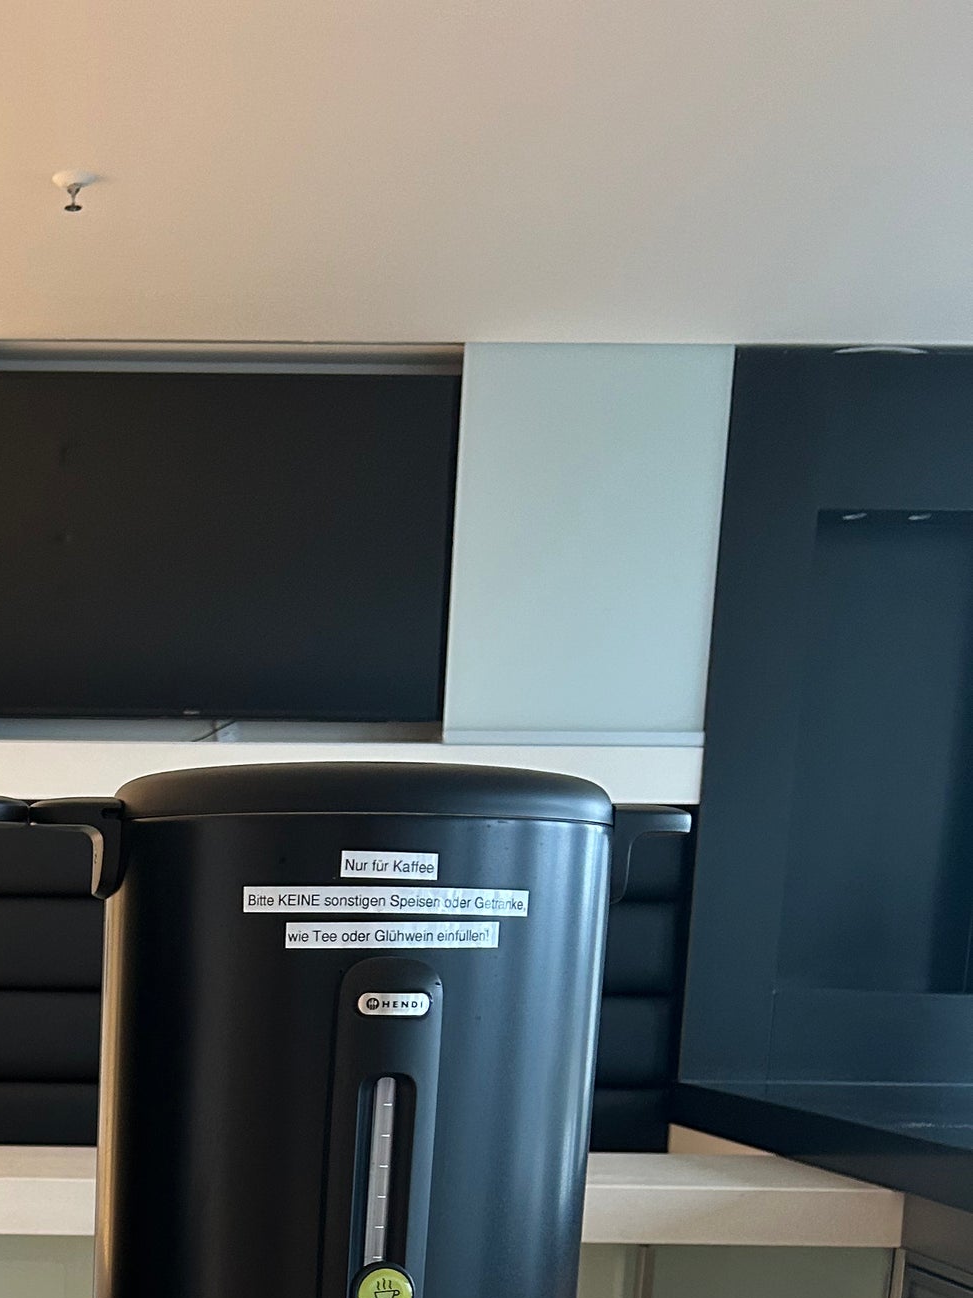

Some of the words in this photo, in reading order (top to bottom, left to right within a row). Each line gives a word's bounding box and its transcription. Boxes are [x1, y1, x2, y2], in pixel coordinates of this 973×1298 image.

[344, 859, 368, 872] Nur
[372, 859, 388, 872] für
[393, 860, 434, 873] Kaffee
[248, 894, 274, 907] Bitte
[278, 894, 320, 907] KEINE
[324, 895, 386, 910] sonstigen
[390, 895, 440, 910] Speisen
[444, 896, 470, 909] oder
[288, 929, 309, 942] wie
[313, 929, 337, 942] Tee
[342, 929, 370, 943] oder
[375, 929, 433, 942] Glühwein
[382, 1000, 424, 1008] HENDI
